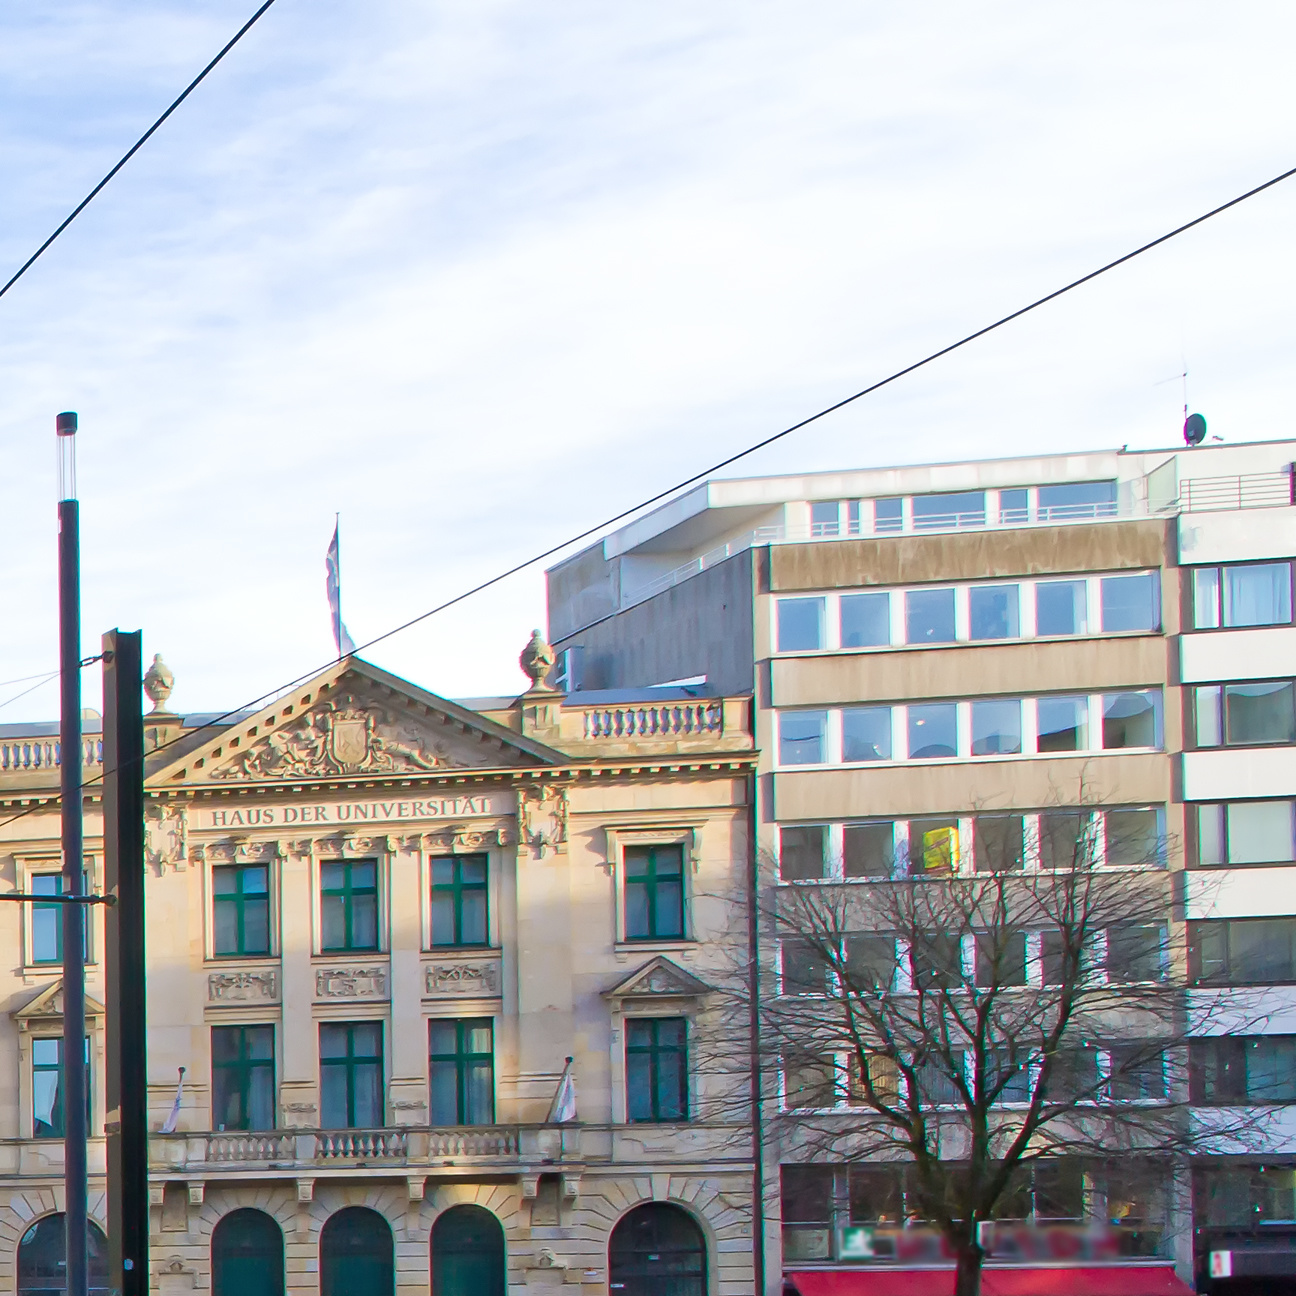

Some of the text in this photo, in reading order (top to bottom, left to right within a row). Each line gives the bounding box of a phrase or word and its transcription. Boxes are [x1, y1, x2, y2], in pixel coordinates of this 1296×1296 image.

[211, 795, 492, 827] HAUS DER UNIVERSITÄT
